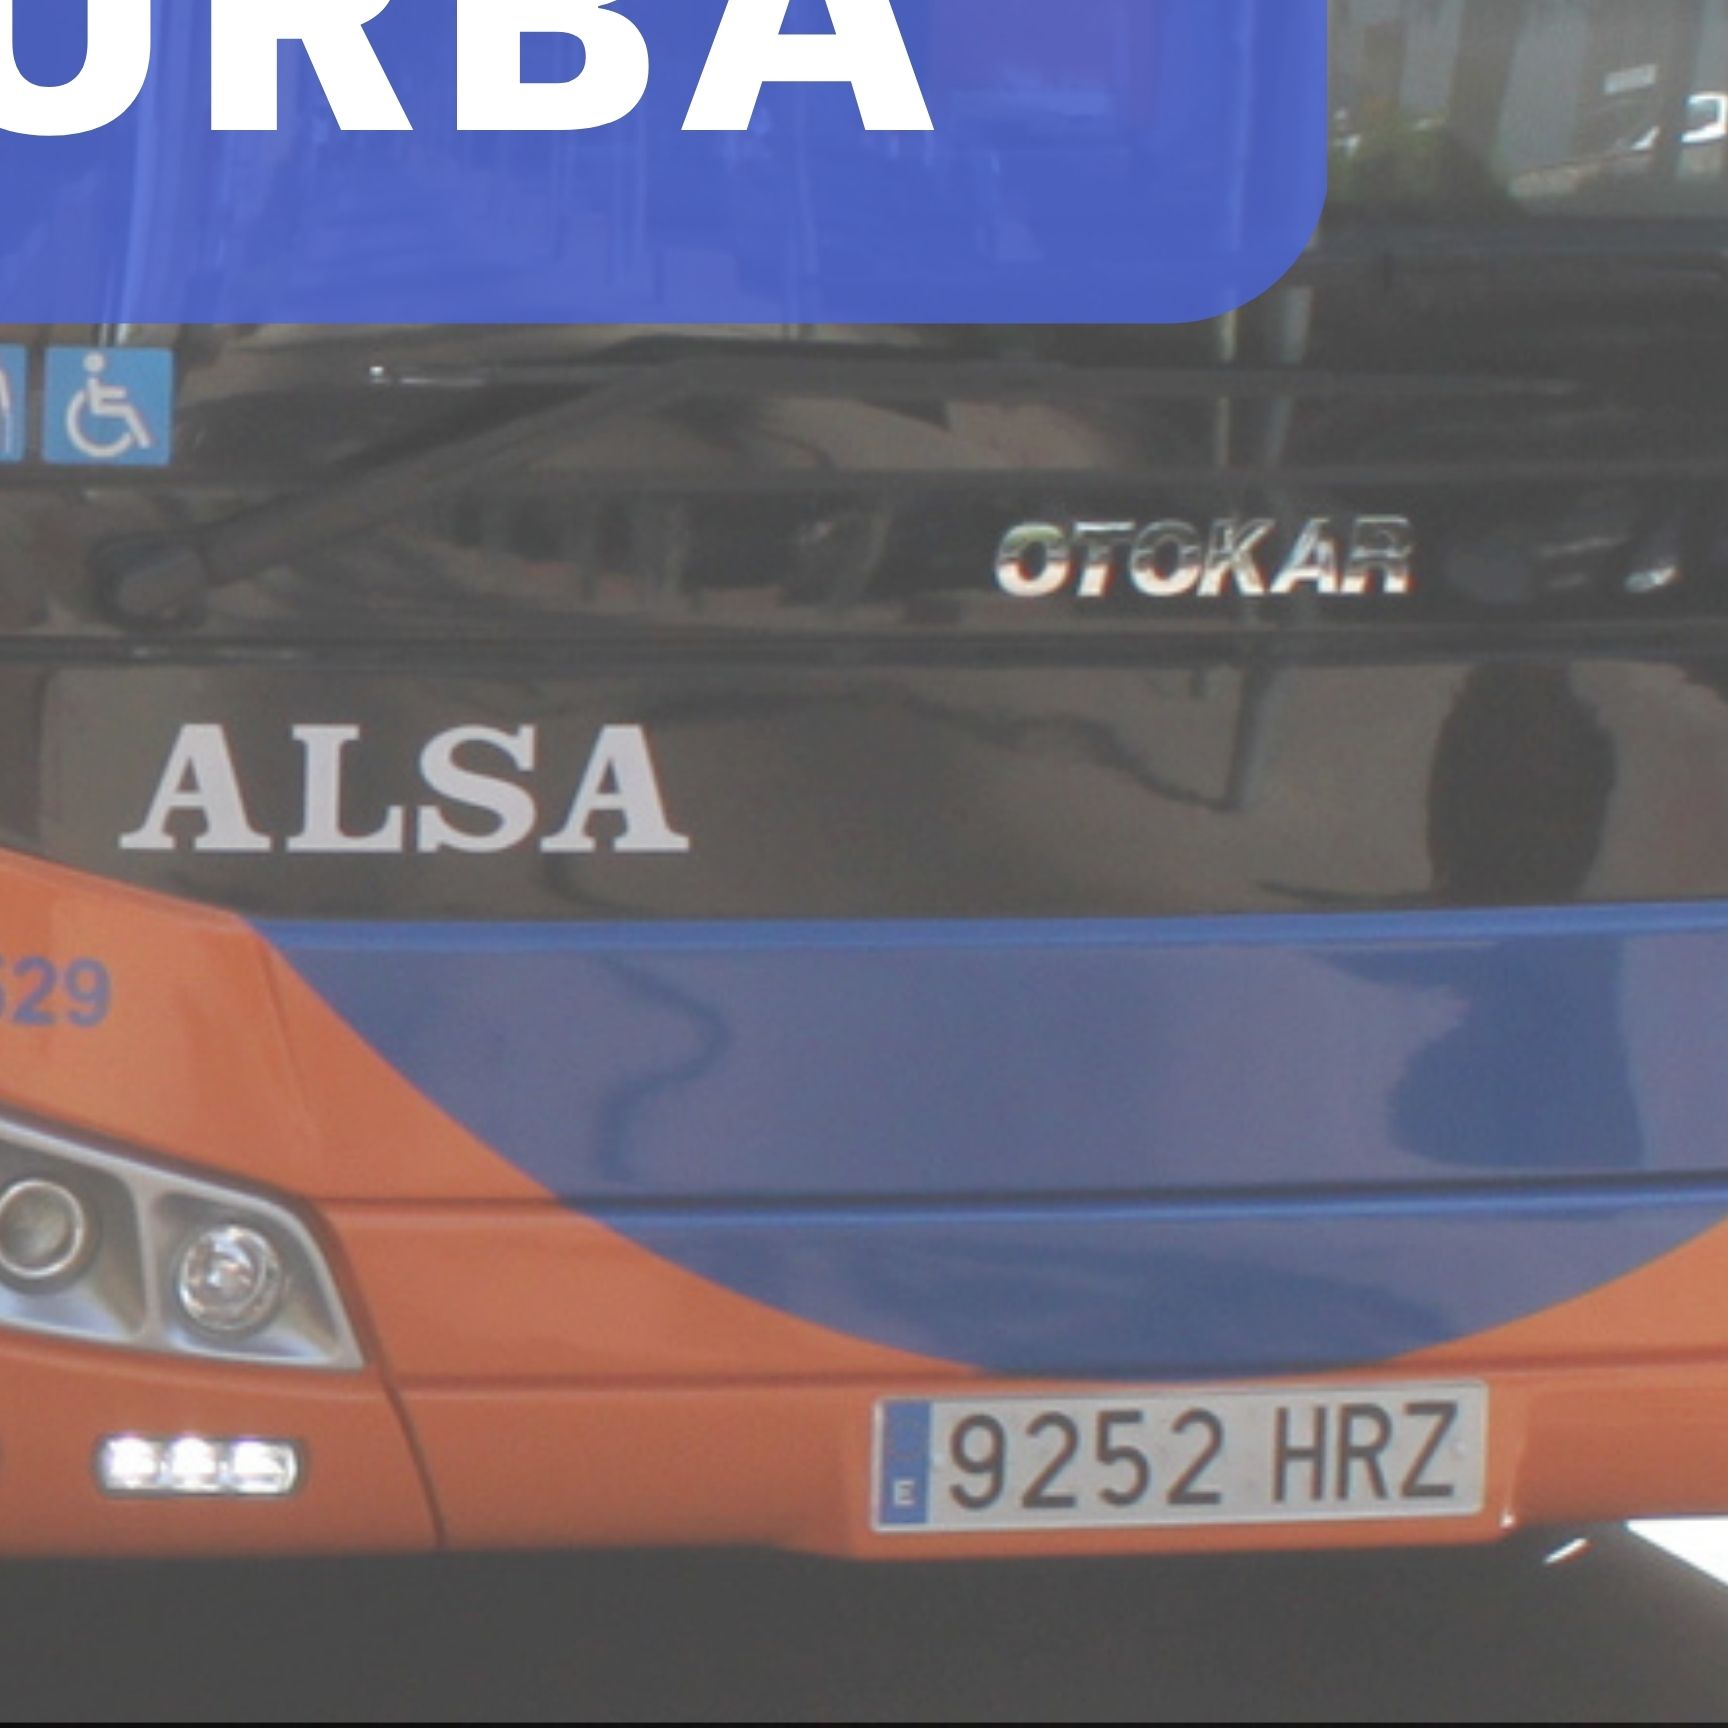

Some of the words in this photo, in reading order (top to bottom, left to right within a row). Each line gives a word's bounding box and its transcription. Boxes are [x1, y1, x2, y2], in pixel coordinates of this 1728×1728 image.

[994, 515, 1412, 599] OTOKAR
[119, 723, 690, 854] ALSA
[892, 1478, 914, 1506] E
[949, 1407, 1224, 1511] 9252
[1272, 1400, 1459, 1502] HRZ
